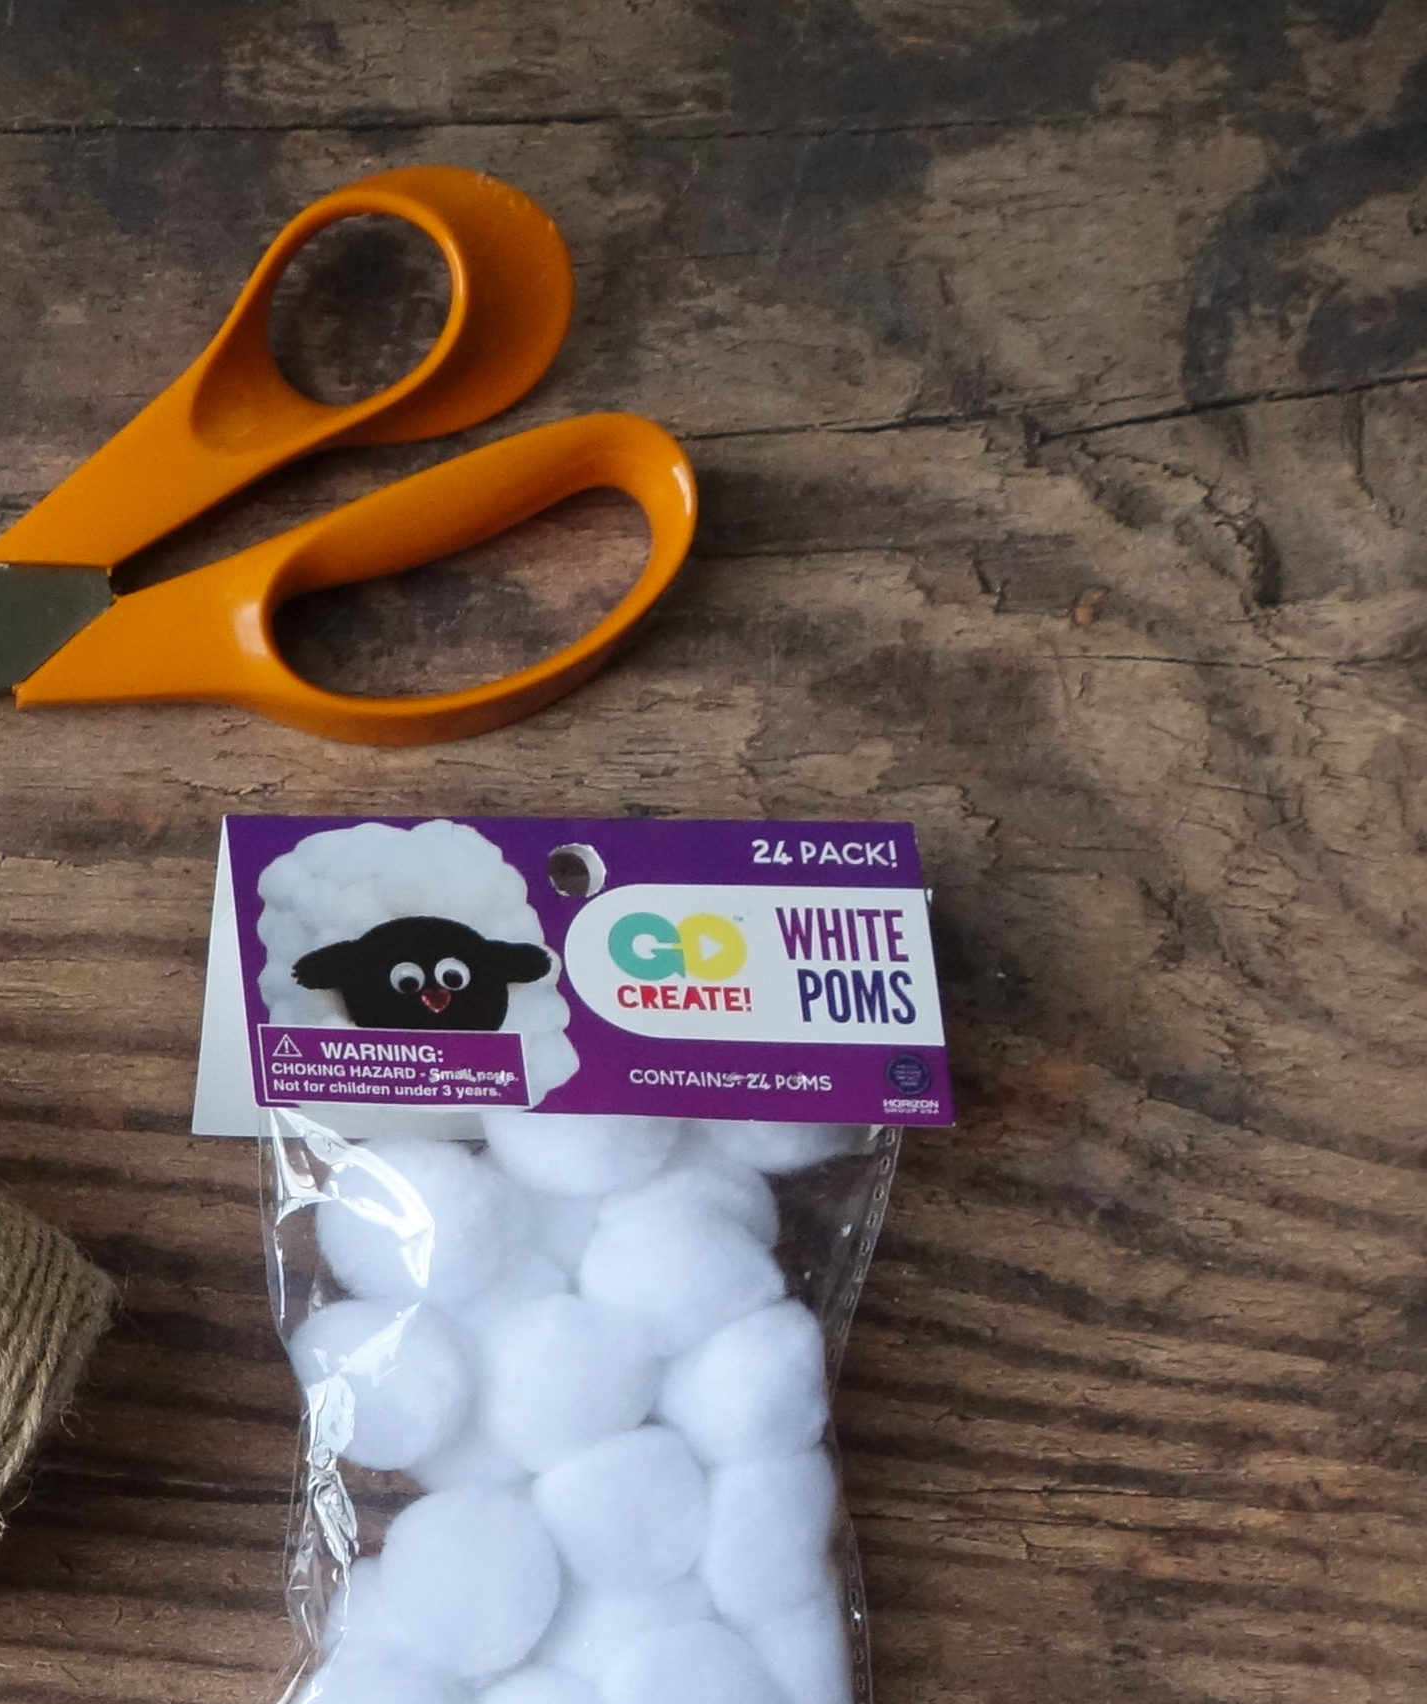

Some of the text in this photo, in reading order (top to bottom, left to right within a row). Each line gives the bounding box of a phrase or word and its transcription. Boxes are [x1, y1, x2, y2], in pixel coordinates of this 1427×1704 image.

[752, 839, 899, 868] 24 PACK!
[776, 906, 909, 963] WHITE
[617, 984, 753, 1012] CREATE!
[797, 969, 917, 1025] POMS
[320, 1041, 445, 1063] WARNING:
[271, 1063, 346, 1077] CHOKING
[350, 1065, 417, 1080] HAZARD
[746, 1072, 771, 1090] 24
[775, 1074, 833, 1092] POMS
[273, 1079, 502, 1100] Not for children under 3 years.
